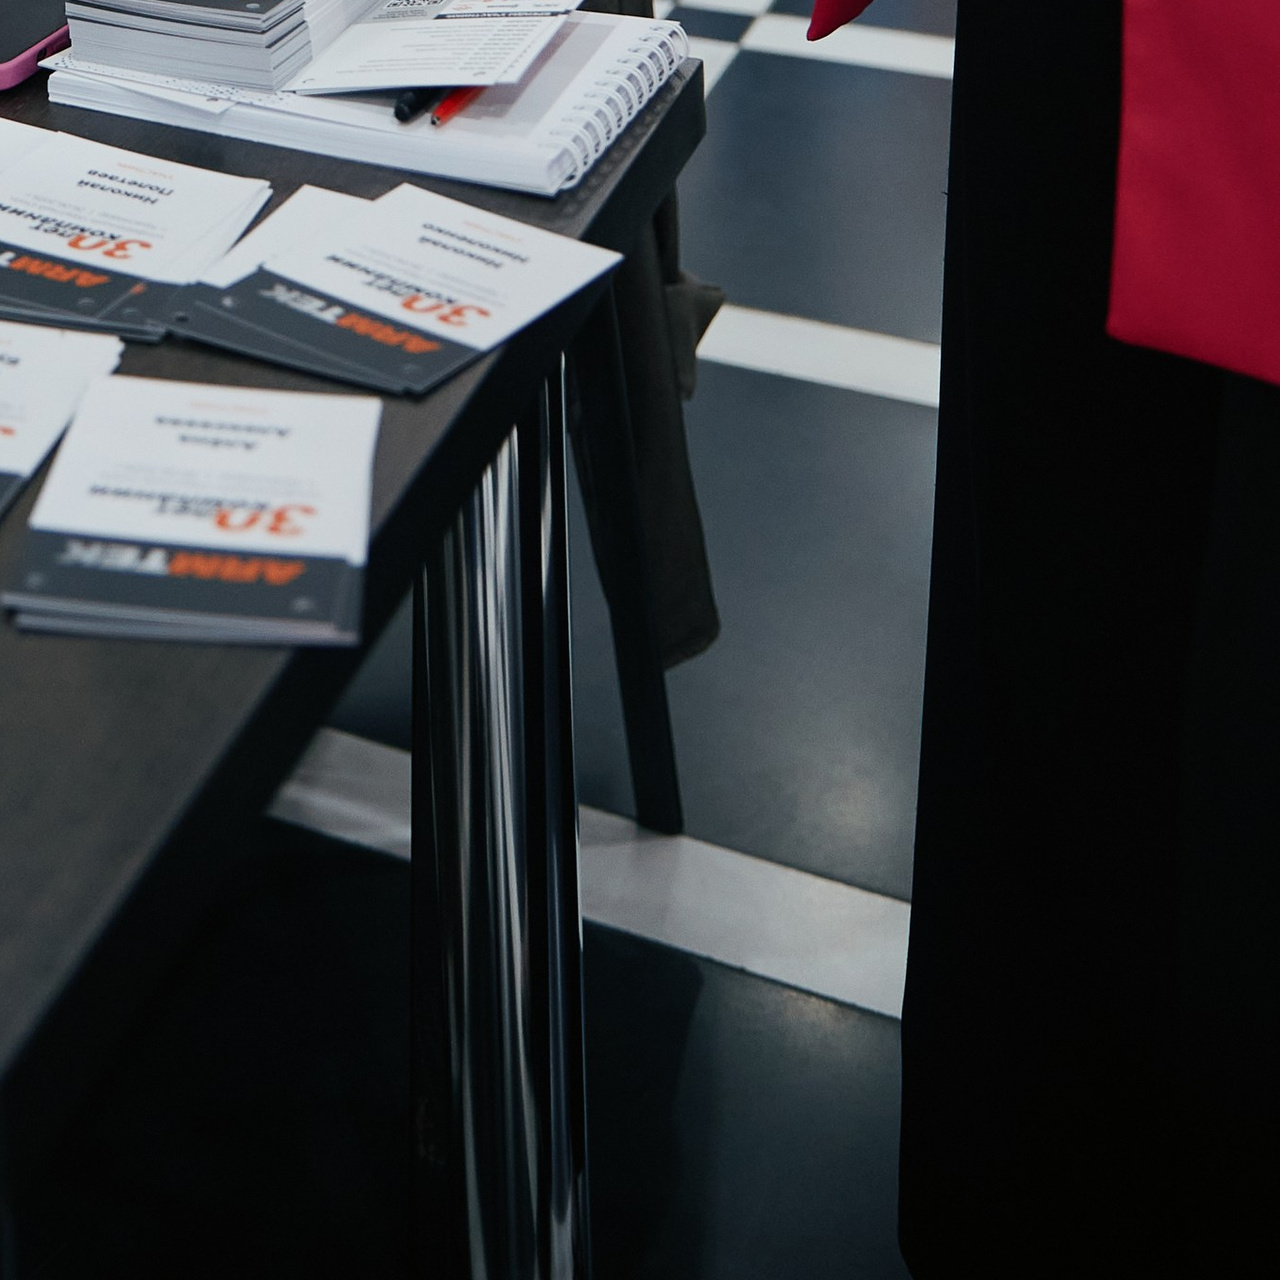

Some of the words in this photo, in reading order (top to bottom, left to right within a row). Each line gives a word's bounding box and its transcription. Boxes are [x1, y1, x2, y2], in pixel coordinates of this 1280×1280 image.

[75, 179, 159, 204] Николай
[85, 169, 174, 195] Полетаев
[29, 222, 78, 238] лет
[65, 230, 153, 261] 30
[326, 254, 458, 306] компании
[364, 278, 413, 299] лет
[259, 282, 439, 356] ARMTEK
[398, 290, 492, 329] 30
[88, 485, 268, 511] компании
[213, 502, 314, 537] 30
[58, 540, 303, 585] ARMTEK
